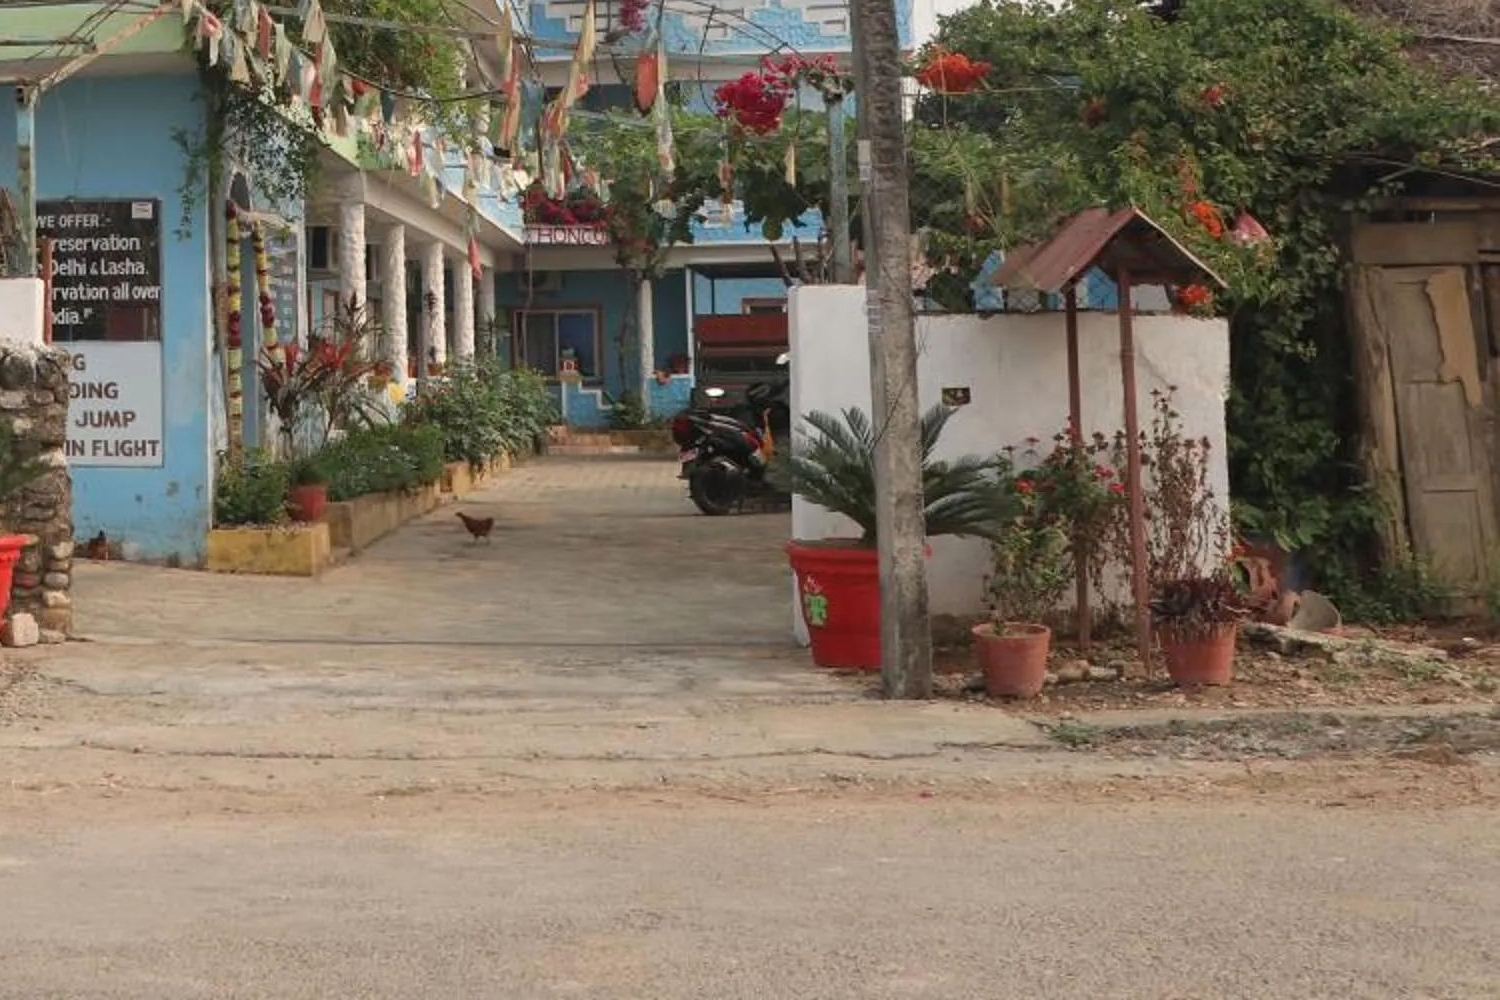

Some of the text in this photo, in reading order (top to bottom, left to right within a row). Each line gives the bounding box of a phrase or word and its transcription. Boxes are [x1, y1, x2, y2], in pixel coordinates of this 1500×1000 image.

[90, 262, 99, 276] &
[52, 282, 161, 301] rvation all over
[69, 382, 119, 400] DING
[75, 411, 136, 429] JUMP
[65, 439, 160, 457] IN FLIGHT
